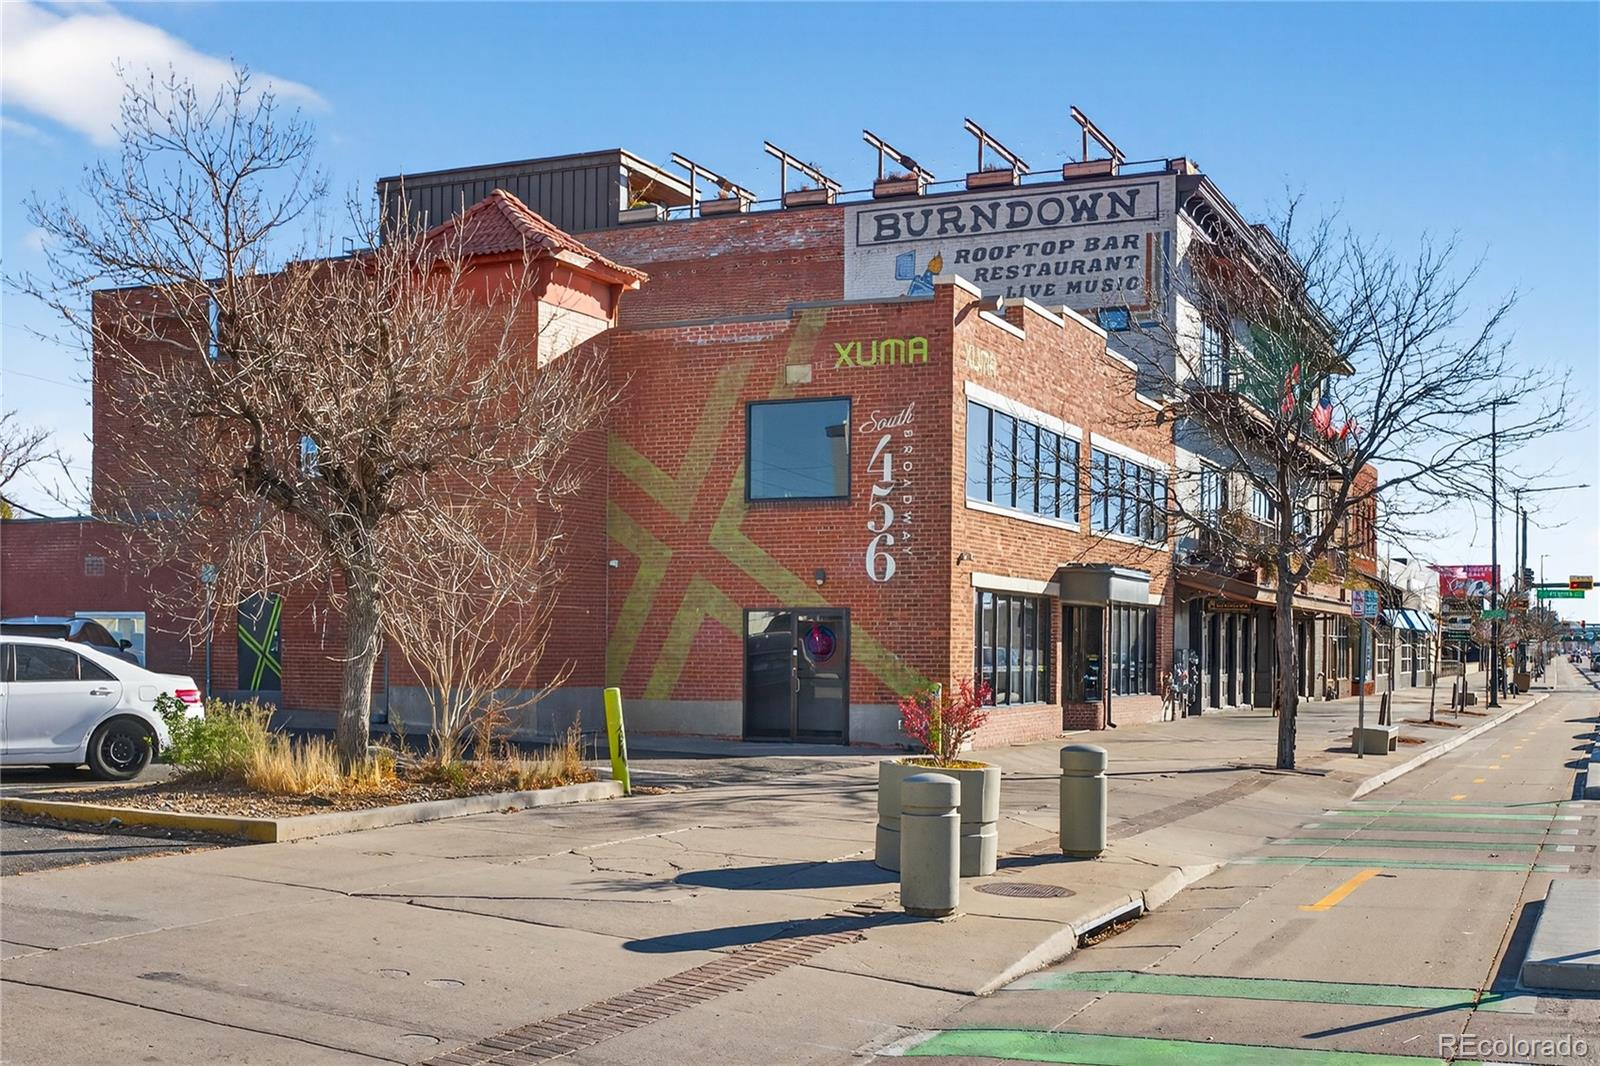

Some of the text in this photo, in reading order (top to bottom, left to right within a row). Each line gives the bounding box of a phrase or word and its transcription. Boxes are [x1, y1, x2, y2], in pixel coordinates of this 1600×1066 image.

[873, 189, 1140, 241] BURNDOWN
[954, 234, 1140, 264] ROOFTOP BAR
[973, 255, 1140, 282] RESTAURANT
[1006, 276, 1140, 299] LIVE MUSIC
[833, 336, 928, 368] XUMA
[859, 401, 915, 433] South
[866, 434, 897, 582] 456
[902, 429, 914, 556] BROADWAY
